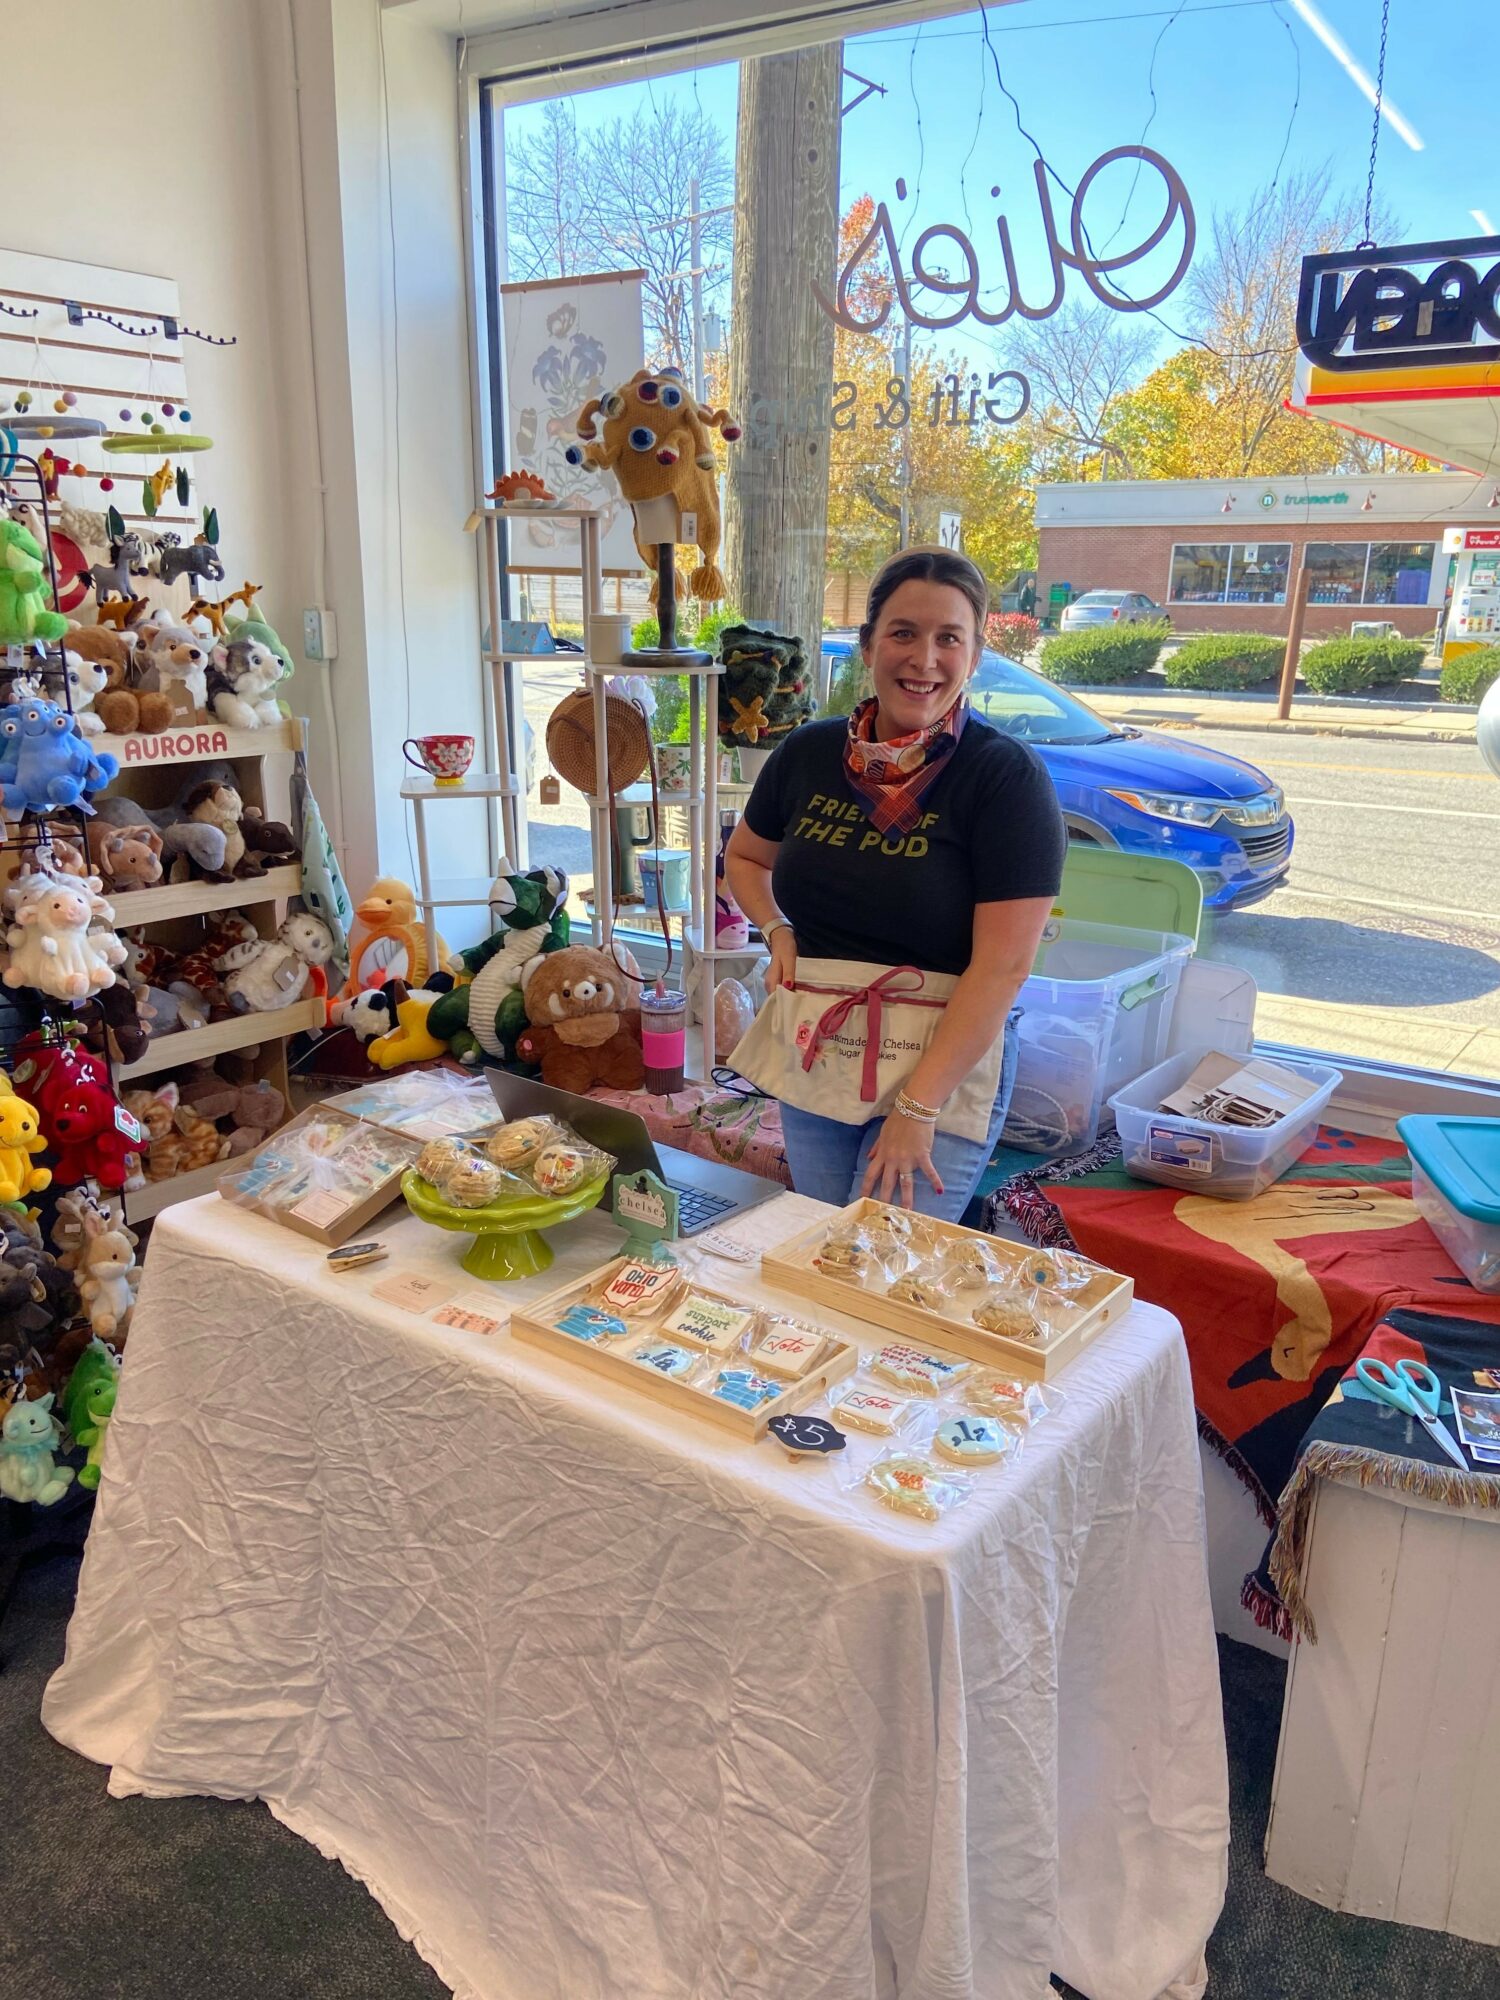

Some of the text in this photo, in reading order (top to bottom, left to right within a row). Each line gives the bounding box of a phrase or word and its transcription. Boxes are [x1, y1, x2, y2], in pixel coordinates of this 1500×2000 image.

[1284, 491, 1349, 505] truenorth
[125, 731, 228, 762] AURORA
[807, 794, 864, 823] FRIE
[794, 817, 929, 858] THE POD
[829, 1034, 868, 1047] andmade
[884, 1039, 921, 1051] Chelsea
[619, 1197, 666, 1219] chelsea
[706, 1232, 751, 1256] chelsea
[611, 1279, 646, 1298] VOTED
[626, 1269, 659, 1287] OHIO
[685, 1309, 731, 1332] support
[677, 1322, 718, 1343] cookie
[775, 1417, 830, 1446] $5
